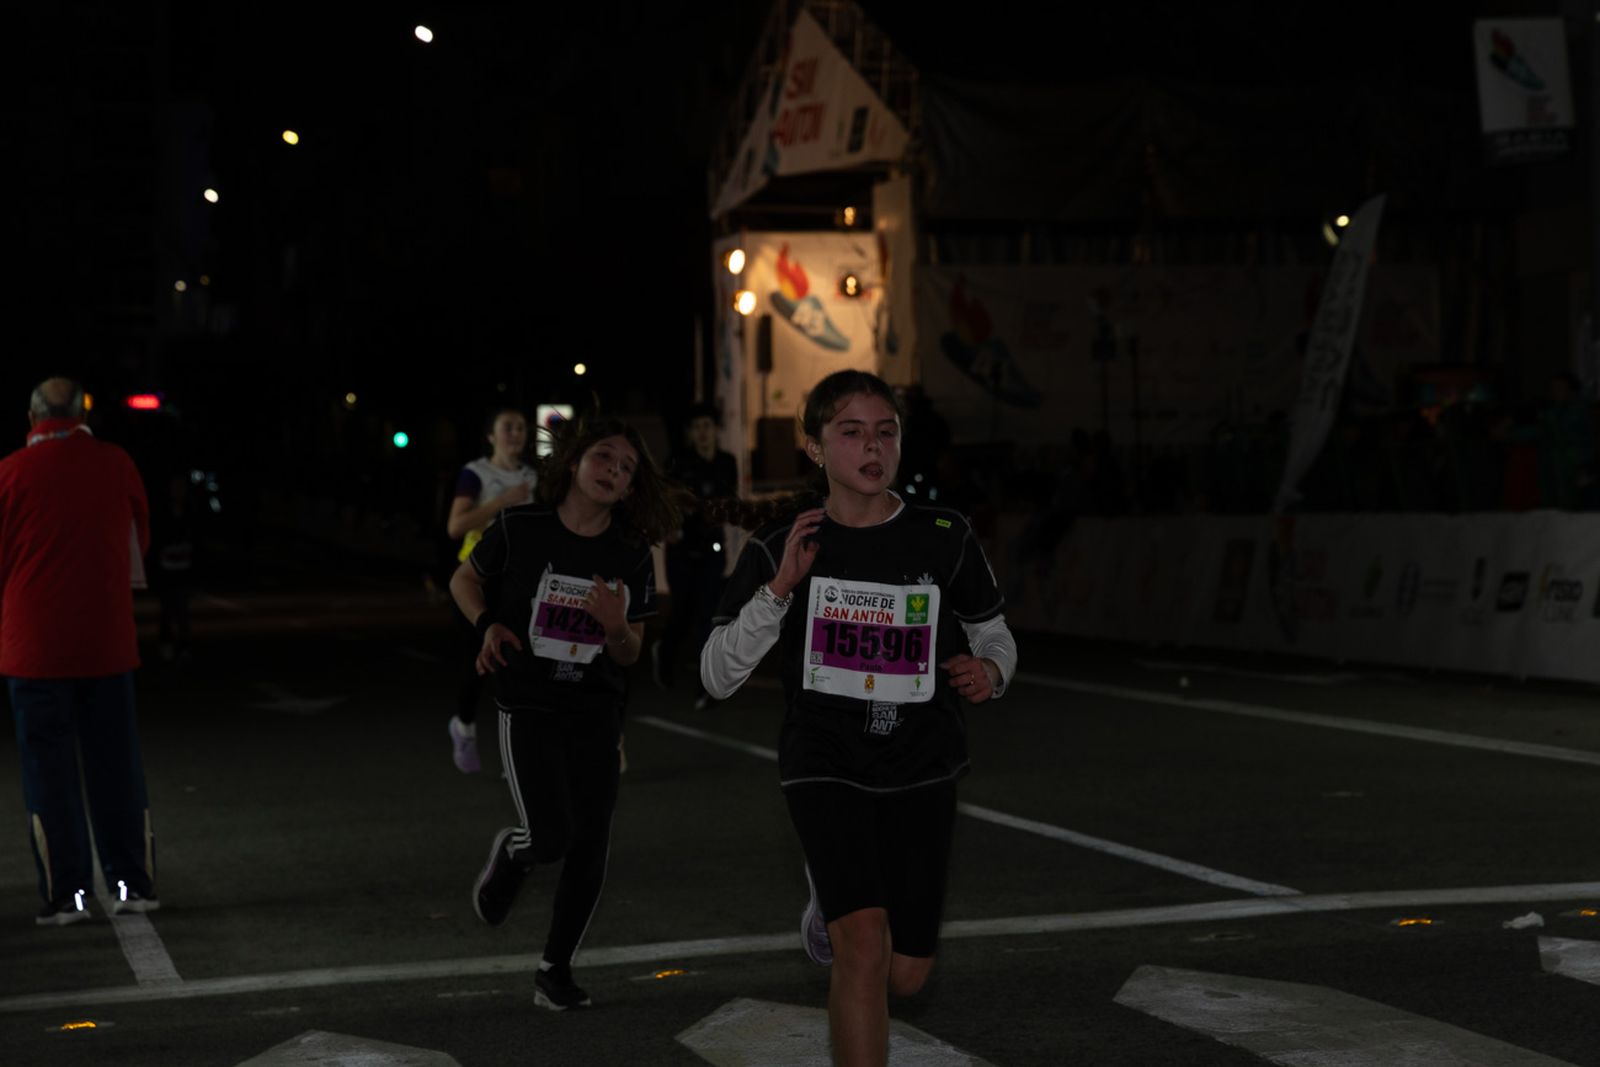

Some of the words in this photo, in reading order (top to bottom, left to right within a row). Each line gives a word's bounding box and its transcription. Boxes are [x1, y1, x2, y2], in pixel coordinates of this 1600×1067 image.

[880, 597, 895, 610] DE
[823, 606, 849, 621] SAN
[852, 608, 895, 625] ANTÓN
[822, 621, 923, 663] 15596
